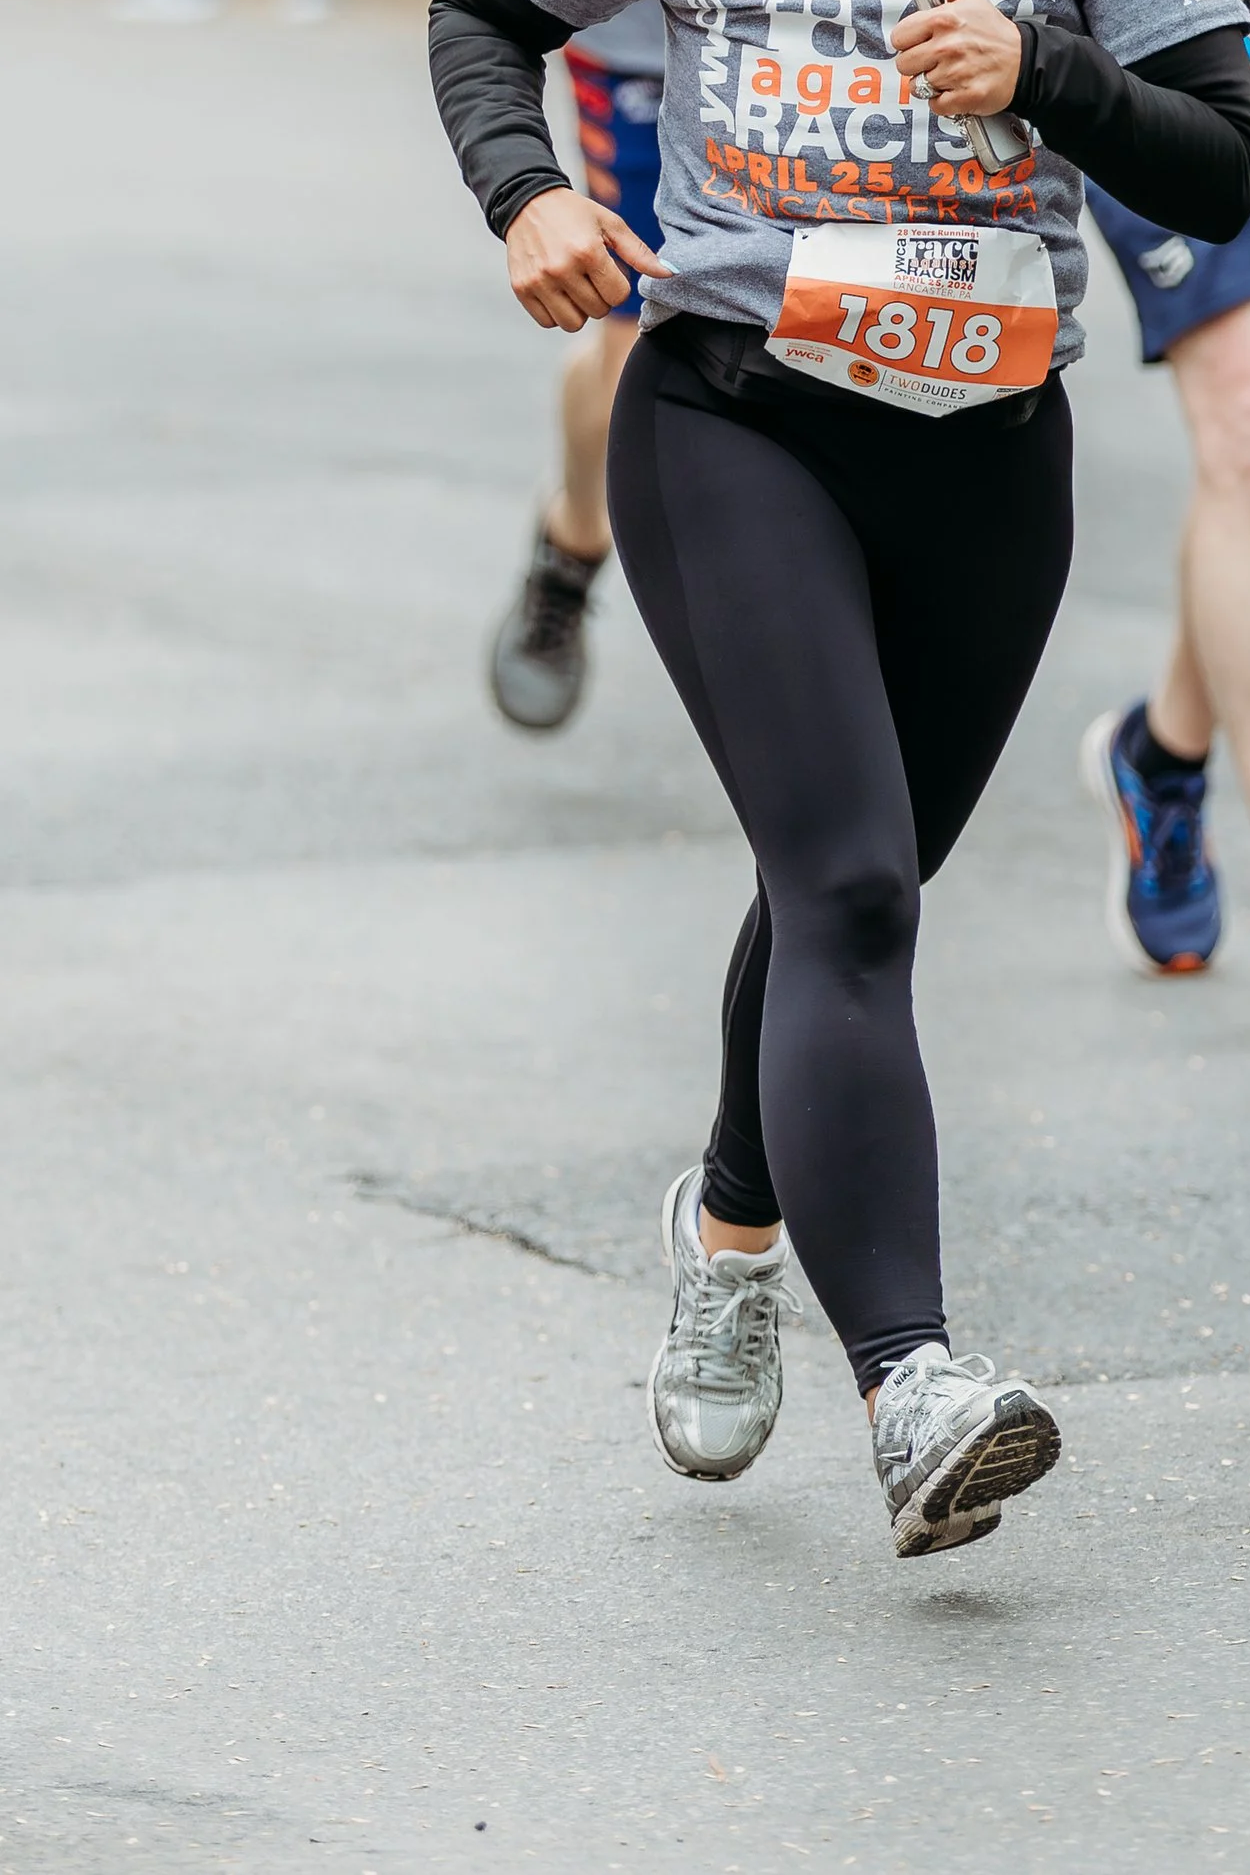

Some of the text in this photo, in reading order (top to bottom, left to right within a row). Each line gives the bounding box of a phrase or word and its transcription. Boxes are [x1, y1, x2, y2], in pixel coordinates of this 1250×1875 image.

[734, 98, 1042, 163] RACIS
[705, 136, 818, 193] APRIL
[830, 160, 912, 196] 25,
[992, 184, 1038, 221] PA
[938, 230, 979, 238] Running!
[895, 238, 907, 273] ywca
[910, 240, 979, 262] race
[907, 262, 977, 282] RACISM
[910, 257, 975, 271] against
[893, 282, 972, 300] LANCASTER, PA
[895, 274, 926, 285] APRIL
[947, 281, 973, 291] 2026
[835, 293, 1002, 375] 1818
[785, 348, 824, 364] ywca
